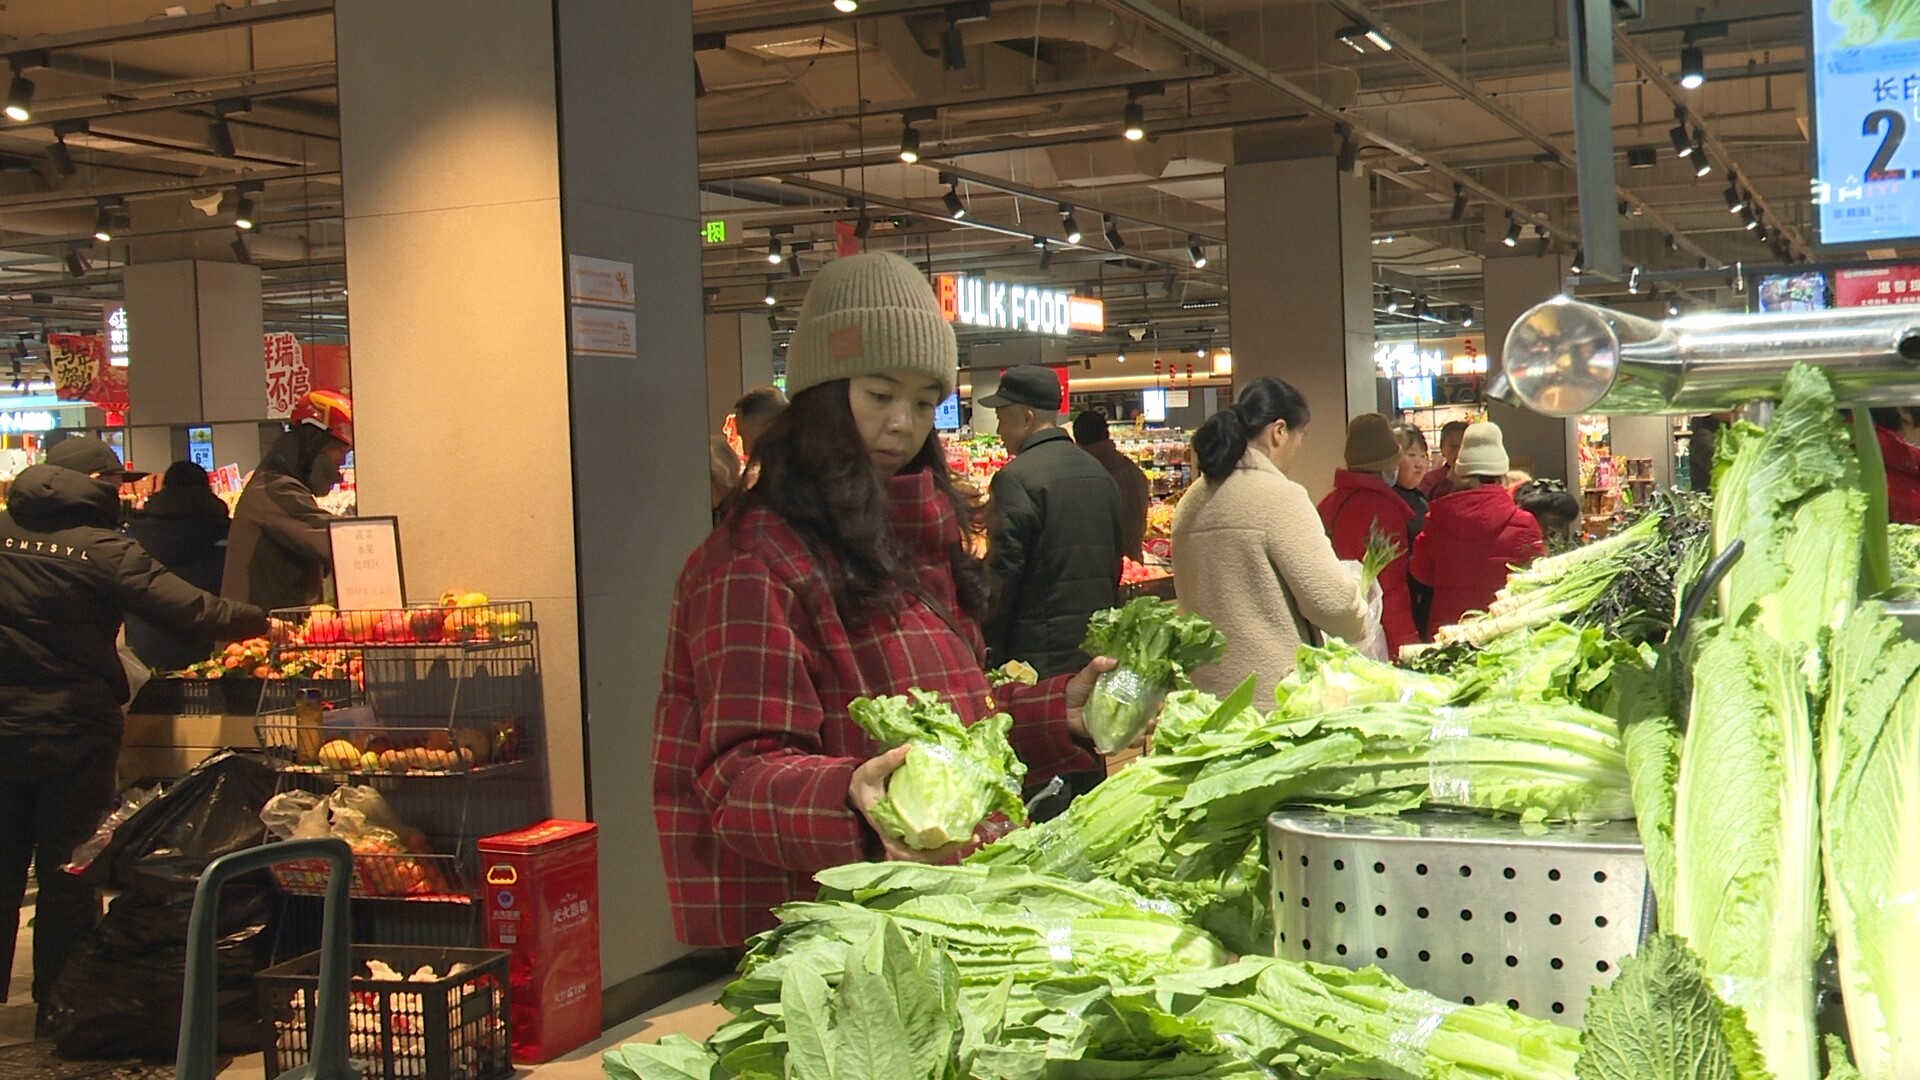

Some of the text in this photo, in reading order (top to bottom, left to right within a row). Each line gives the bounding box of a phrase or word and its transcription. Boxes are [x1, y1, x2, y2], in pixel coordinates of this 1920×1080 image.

[940, 275, 1006, 328] BULK
[1011, 285, 1069, 334] FOOD
[5, 538, 88, 560] CMTSYL
